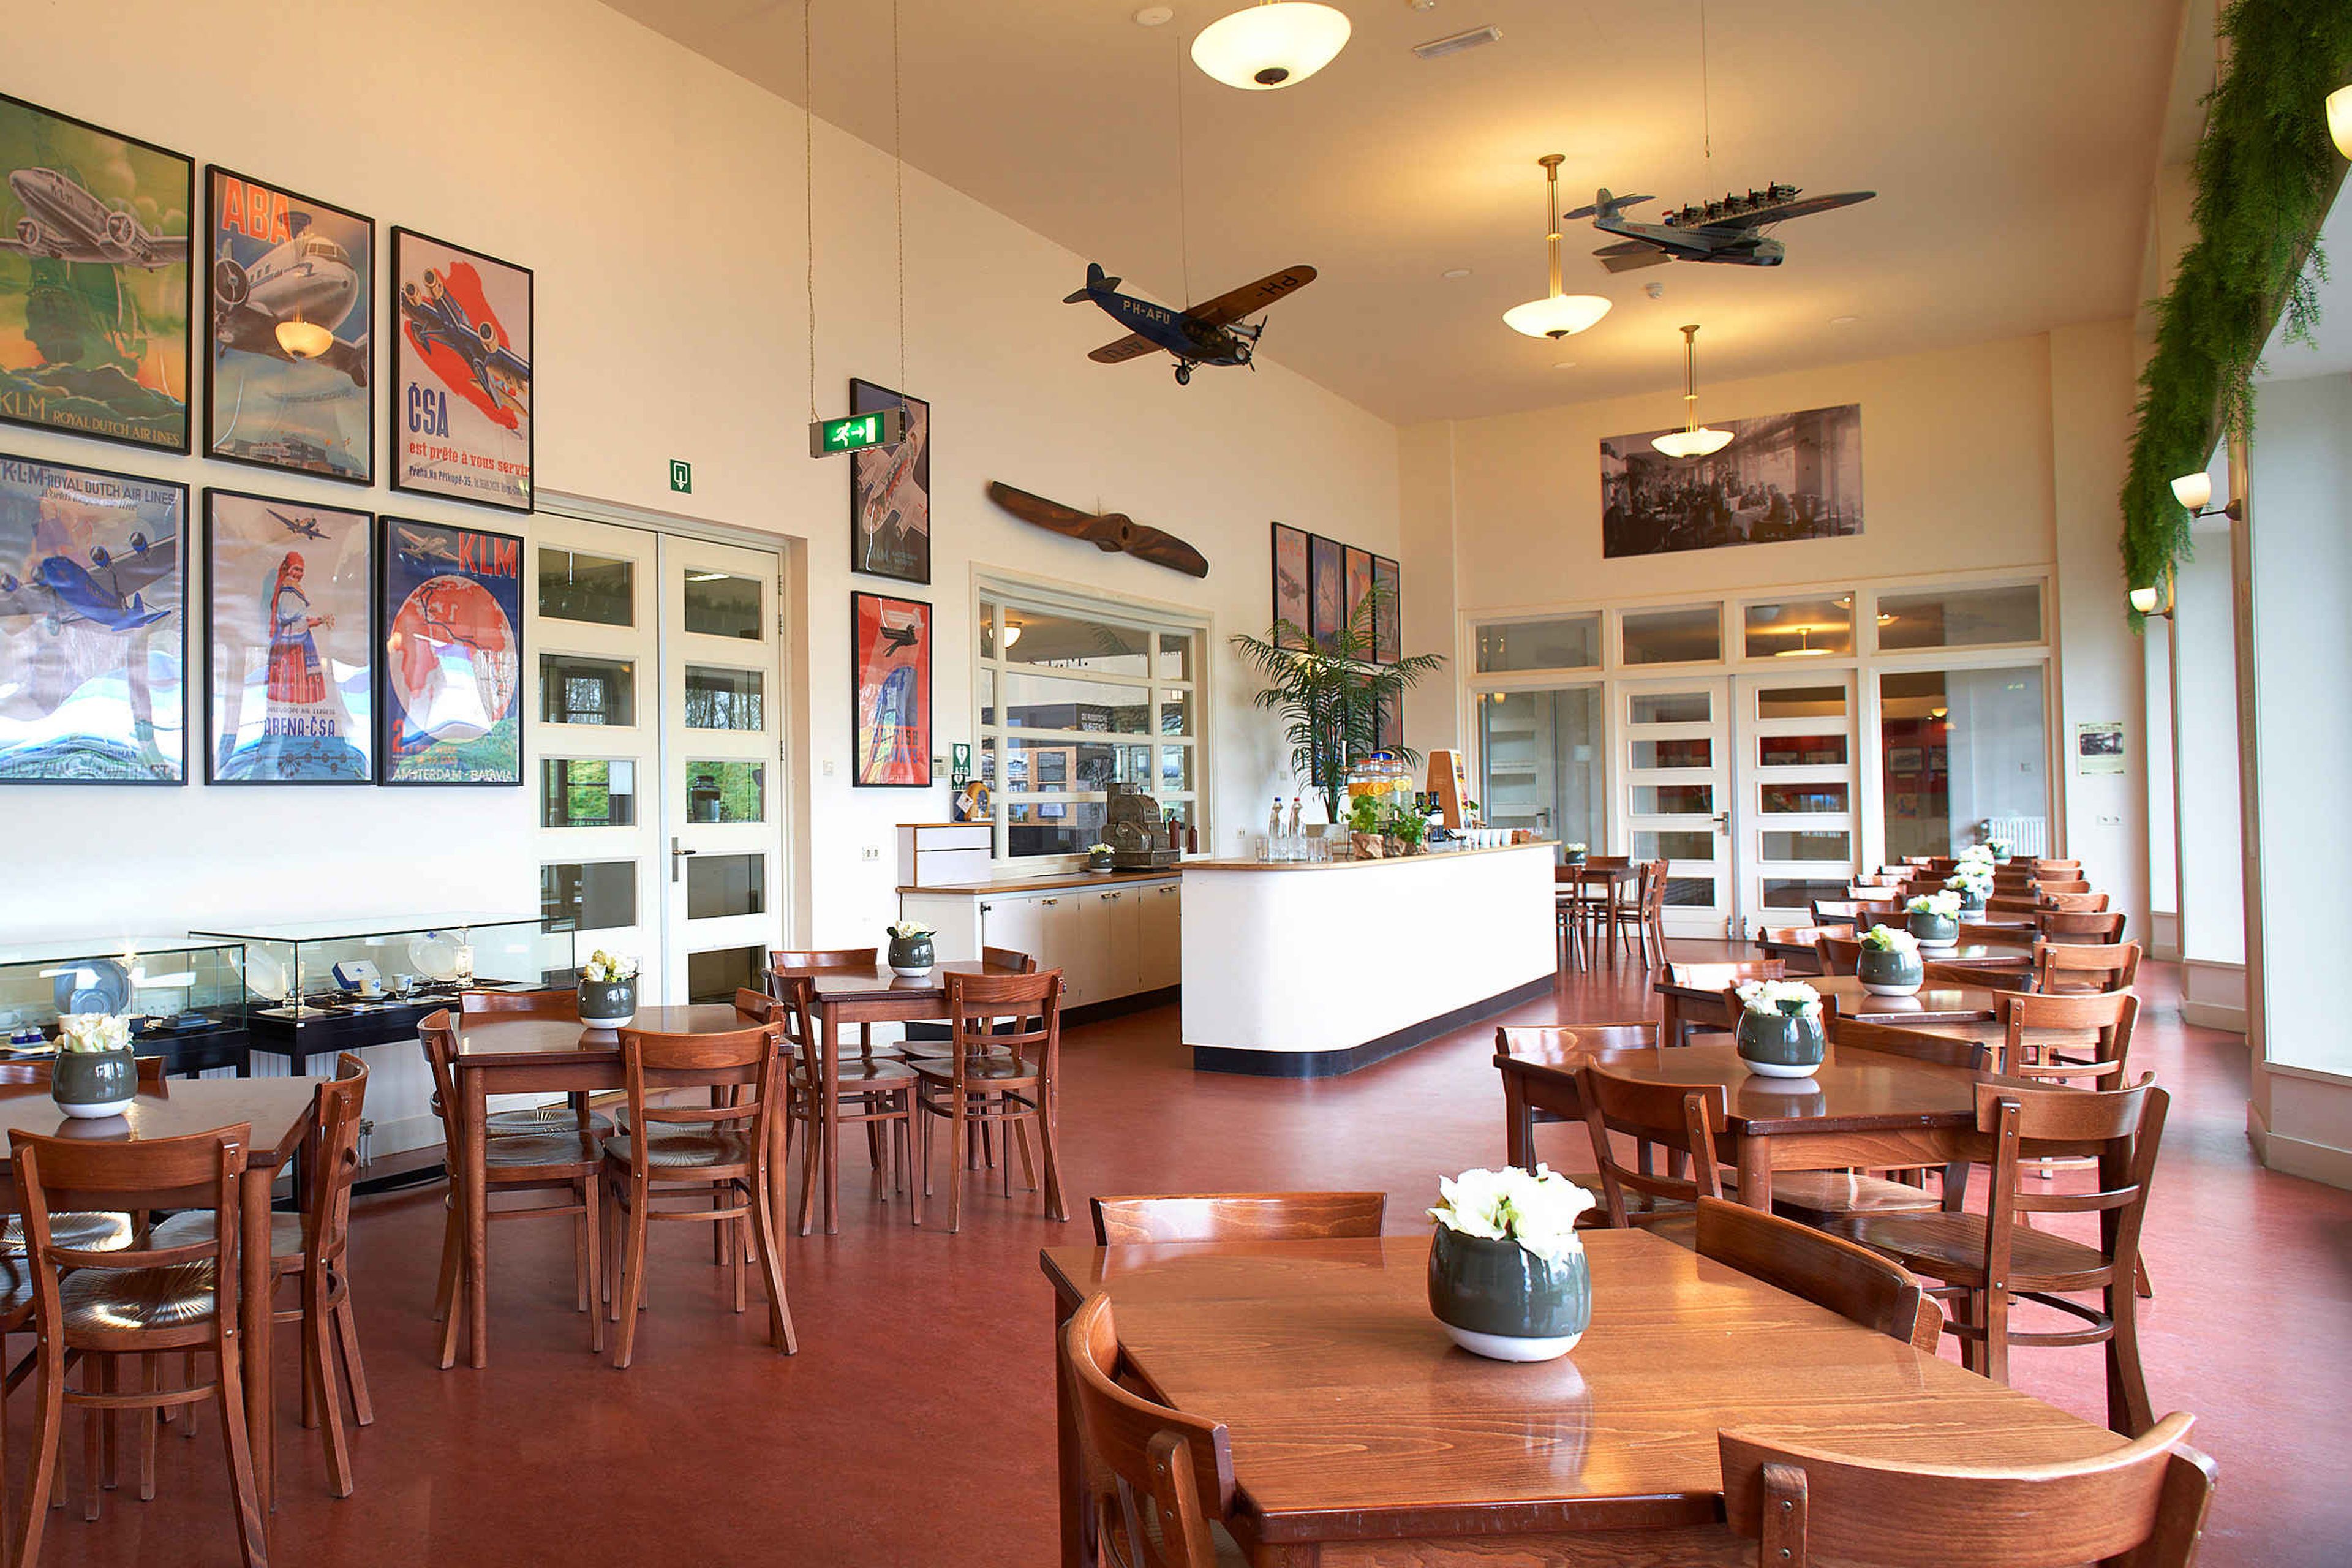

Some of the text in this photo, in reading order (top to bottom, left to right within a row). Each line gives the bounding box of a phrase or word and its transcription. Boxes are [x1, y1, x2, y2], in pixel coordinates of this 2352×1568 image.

[222, 176, 293, 244] ABA
[1122, 299, 1170, 325] PH-AFU
[1, 391, 180, 446] KLM ROYAL DUTCH AIR LINES
[407, 382, 449, 438] ČSA
[409, 442, 530, 478] est prête à vous servir
[85, 481, 121, 498] DUTCH
[123, 488, 142, 501] AIR
[145, 491, 176, 506] LINES
[458, 532, 517, 579] KLM
[392, 767, 462, 781] AMSTERDAM
[470, 768, 512, 782] BATAVIA
